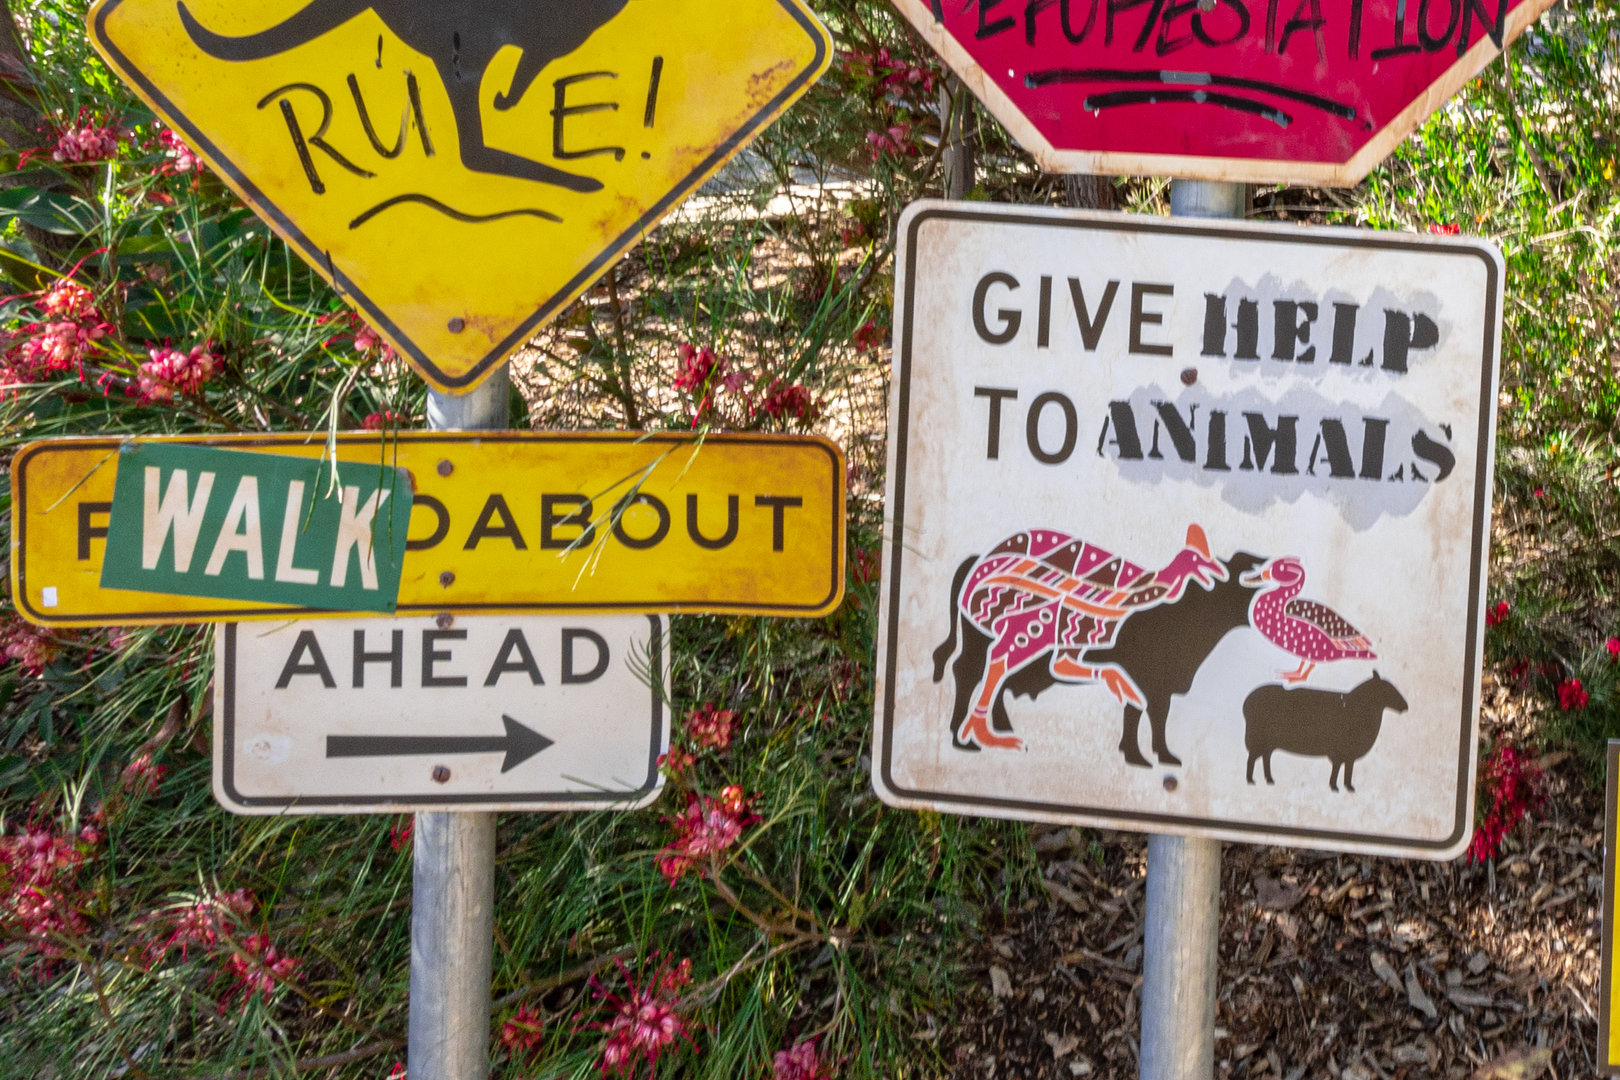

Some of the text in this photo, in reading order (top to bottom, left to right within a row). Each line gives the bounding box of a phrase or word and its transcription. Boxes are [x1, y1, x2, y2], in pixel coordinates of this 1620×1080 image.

[972, 272, 1440, 375] GIVE HELP
[974, 386, 1456, 483] TO ANIMALS
[141, 465, 392, 590] WALK
[275, 627, 610, 689] AHEAD
